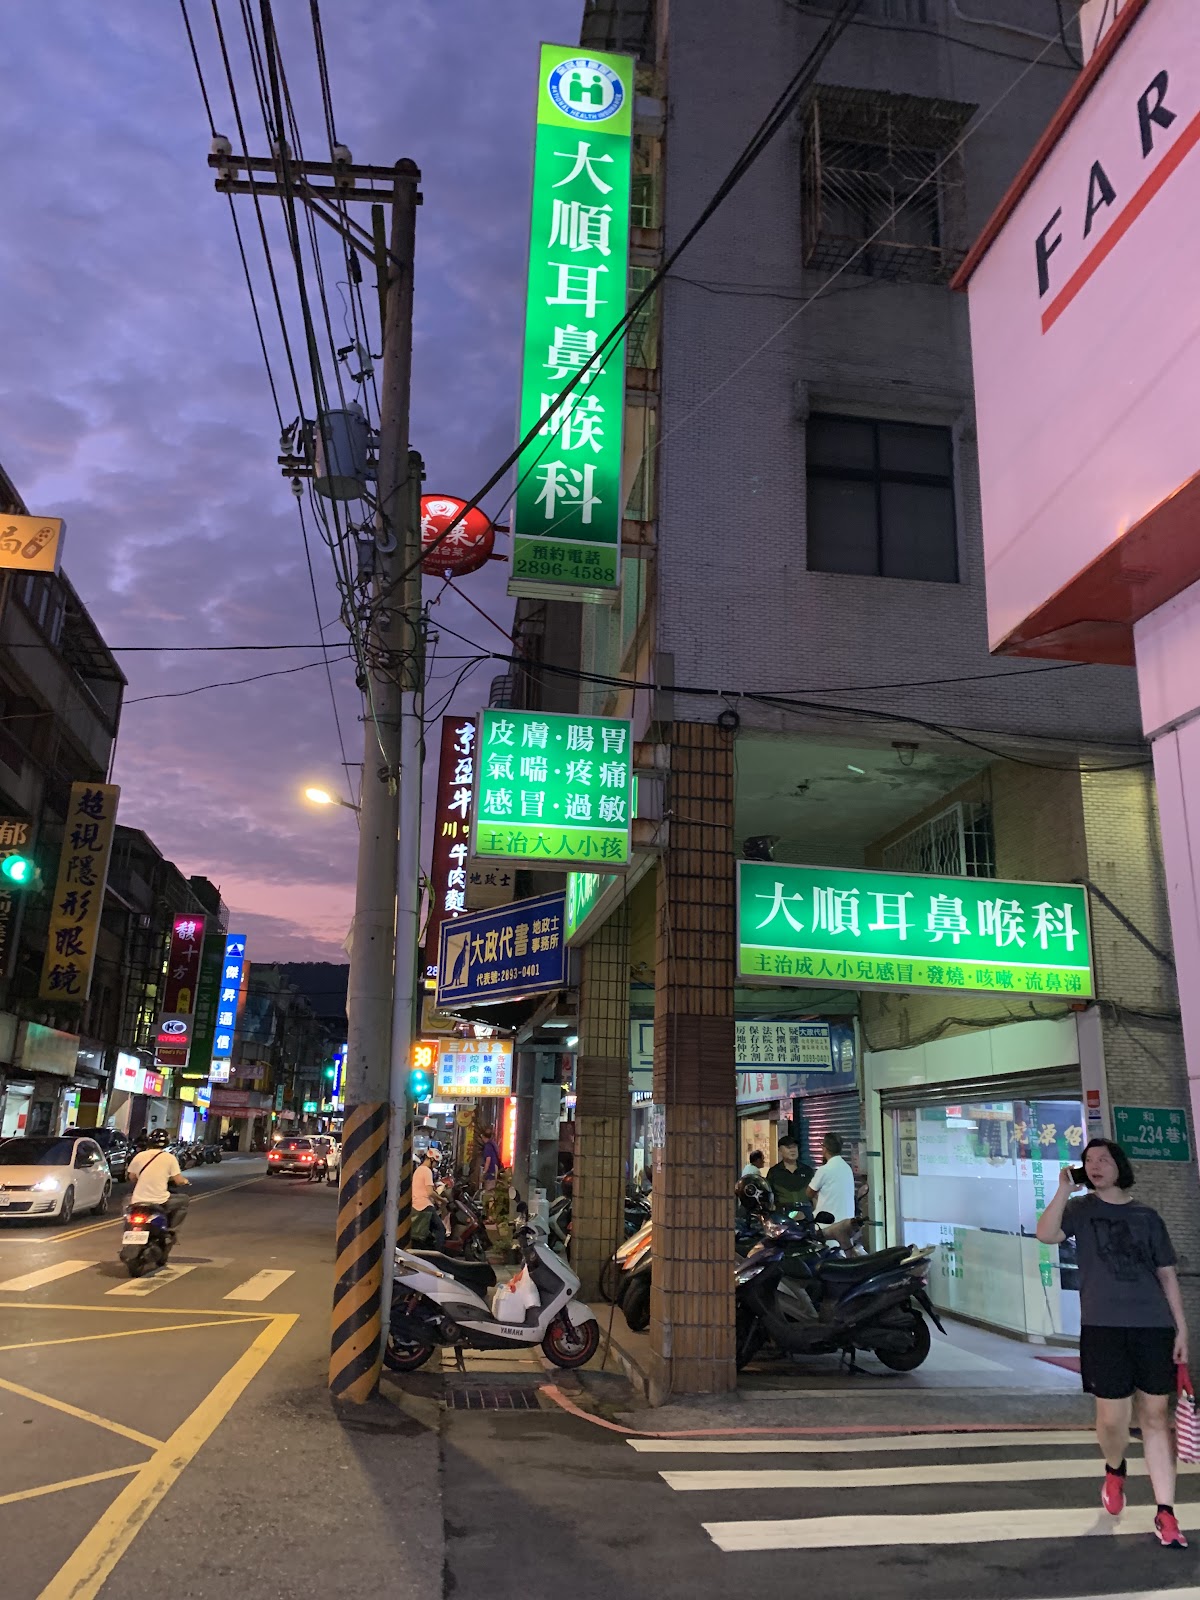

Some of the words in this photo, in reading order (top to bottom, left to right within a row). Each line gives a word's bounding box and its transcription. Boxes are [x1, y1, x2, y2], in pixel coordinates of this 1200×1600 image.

[570, 108, 597, 120] HEALTH
[1035, 69, 1178, 299] FAR
[534, 140, 615, 525] 大順耳鼻喉科
[532, 545, 601, 565] 預約電話
[516, 559, 616, 582] 2896-4588
[481, 830, 623, 860] 主治大人小孩
[48, 788, 108, 995] 超視隱形眼鏡
[469, 872, 511, 888] 地政士
[532, 915, 560, 935] 地政士
[755, 882, 1079, 952] 大順耳鼻喉科
[470, 923, 530, 967] 大政代書
[531, 932, 559, 954] 事務所
[216, 965, 240, 1050] 傑昇通信
[800, 1028, 828, 1036] 大政代書
[483, 1054, 492, 1085] 鮮魚飯
[1117, 1110, 1181, 1125] 中和街
[501, 1327, 523, 1336] YAMAHA
